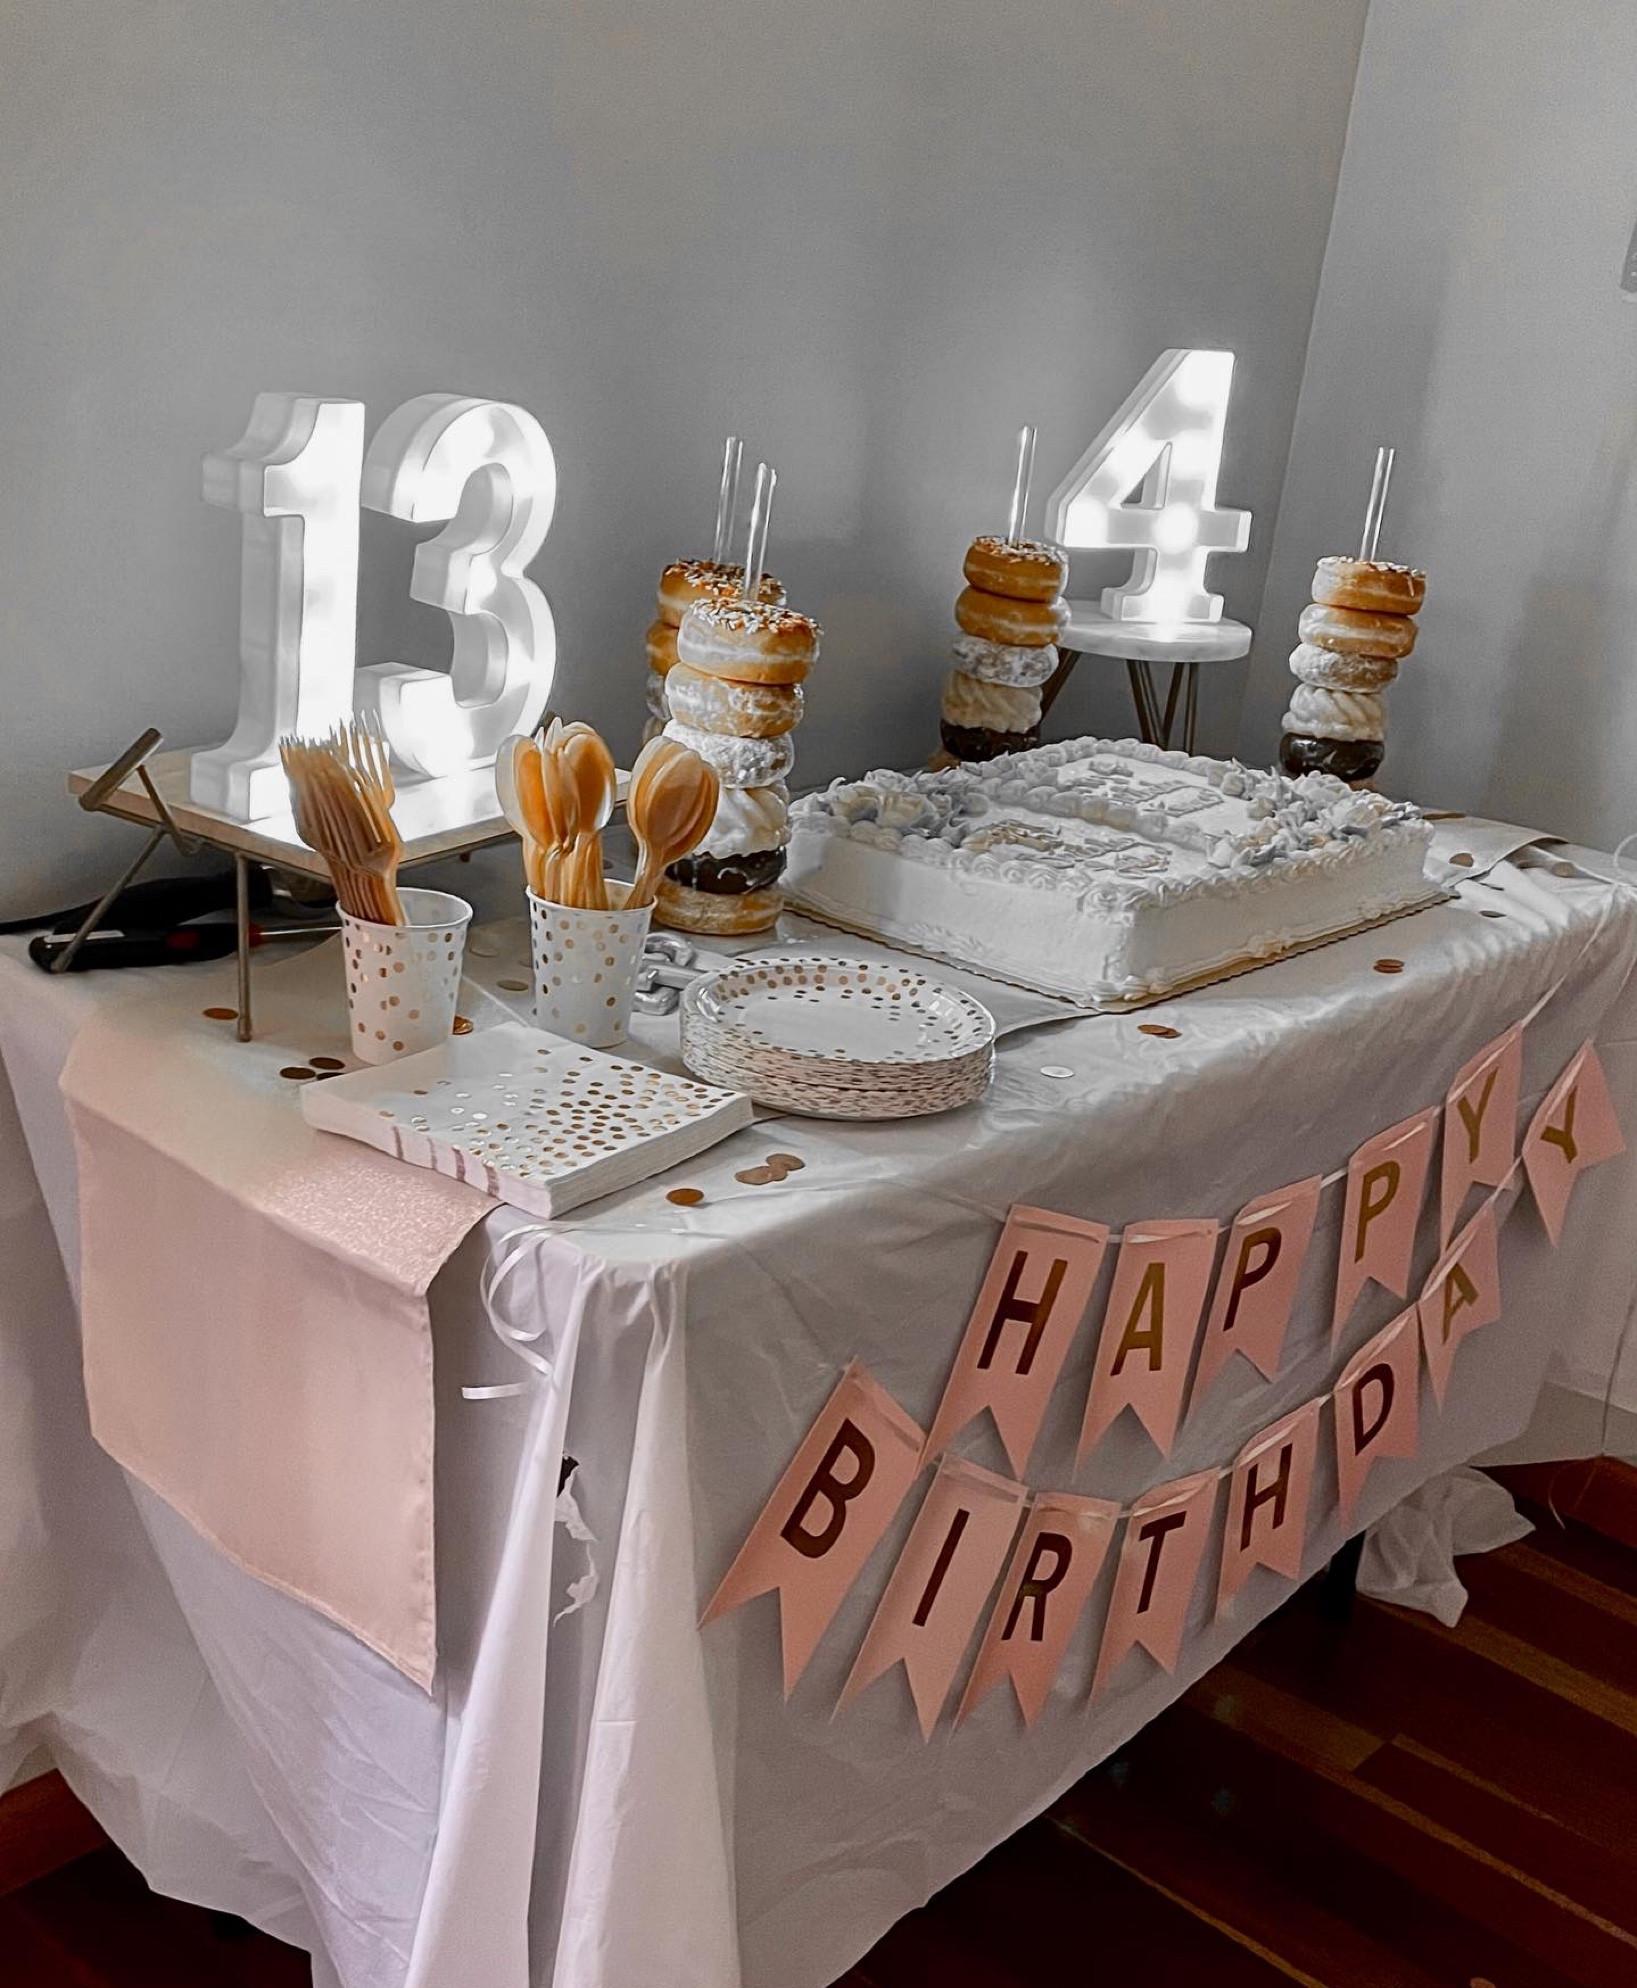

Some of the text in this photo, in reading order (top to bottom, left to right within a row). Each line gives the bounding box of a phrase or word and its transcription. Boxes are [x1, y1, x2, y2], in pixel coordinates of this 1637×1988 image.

[195, 393, 557, 819] 13
[1046, 348, 1252, 623] 4
[780, 1084, 1578, 1642] BIRTHDAY
[976, 1066, 1500, 1376] HAPPY
